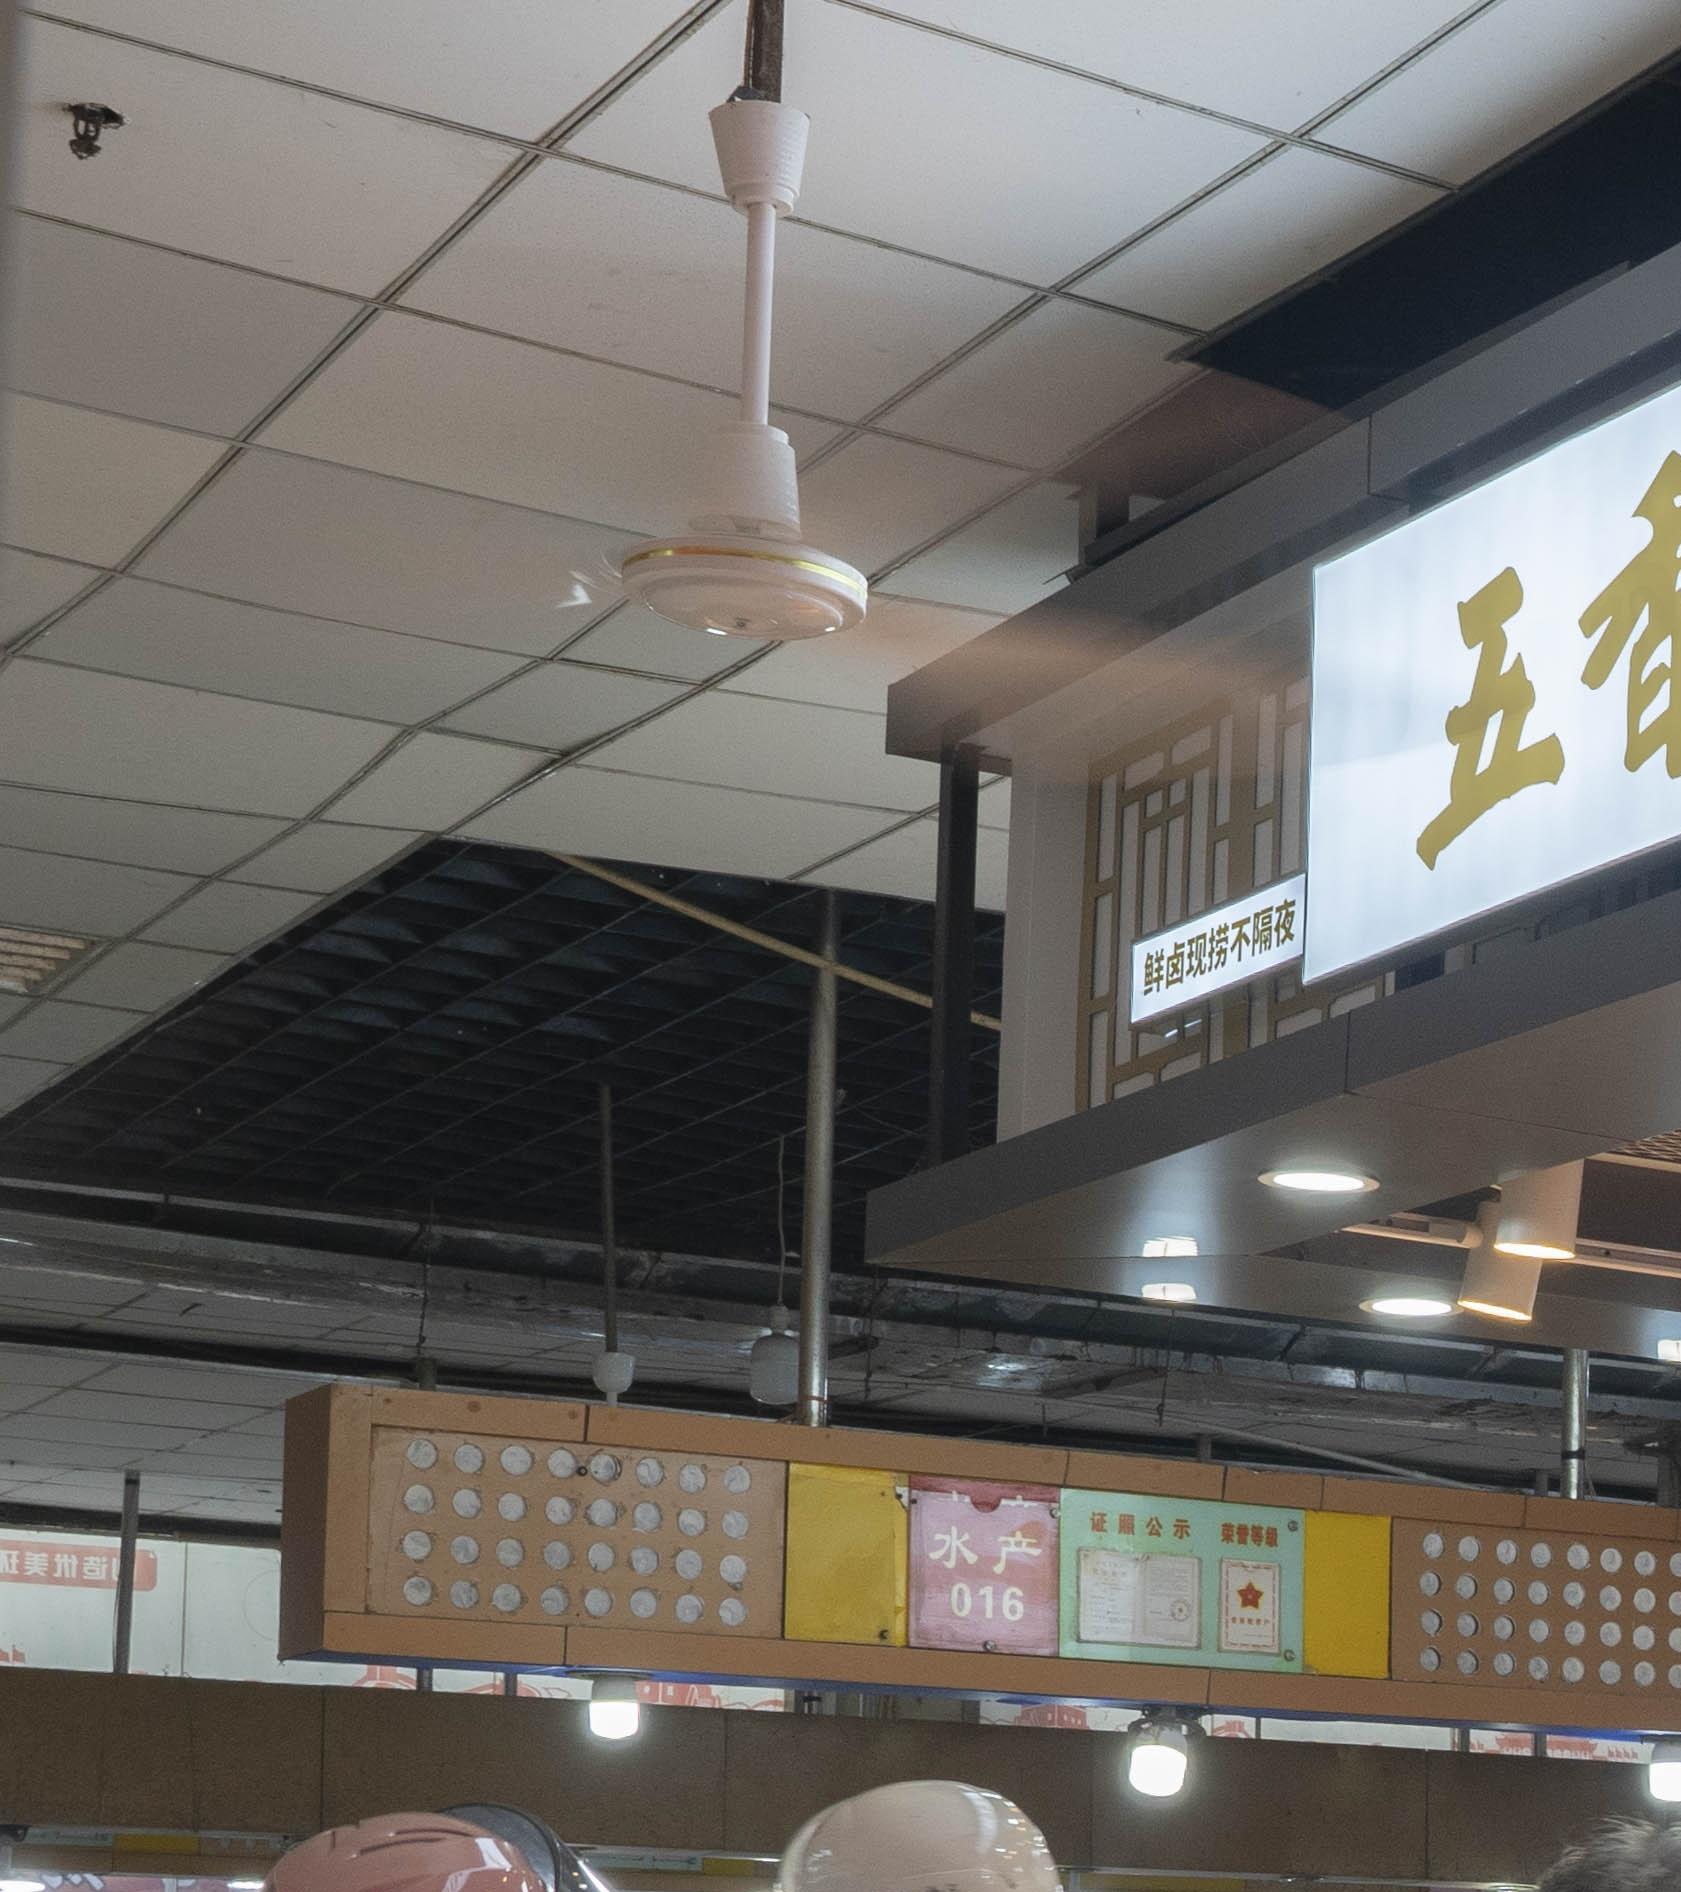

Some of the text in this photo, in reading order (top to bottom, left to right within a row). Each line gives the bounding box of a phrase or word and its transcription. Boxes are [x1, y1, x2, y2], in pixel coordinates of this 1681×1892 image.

[1143, 898, 1297, 996] 鲜卤现捞不隔夜
[1090, 1510, 1192, 1541] 证照公示
[1221, 1522, 1280, 1549] 荣誉等级
[928, 1524, 1043, 1575] 水产
[949, 1581, 1025, 1622] 016
